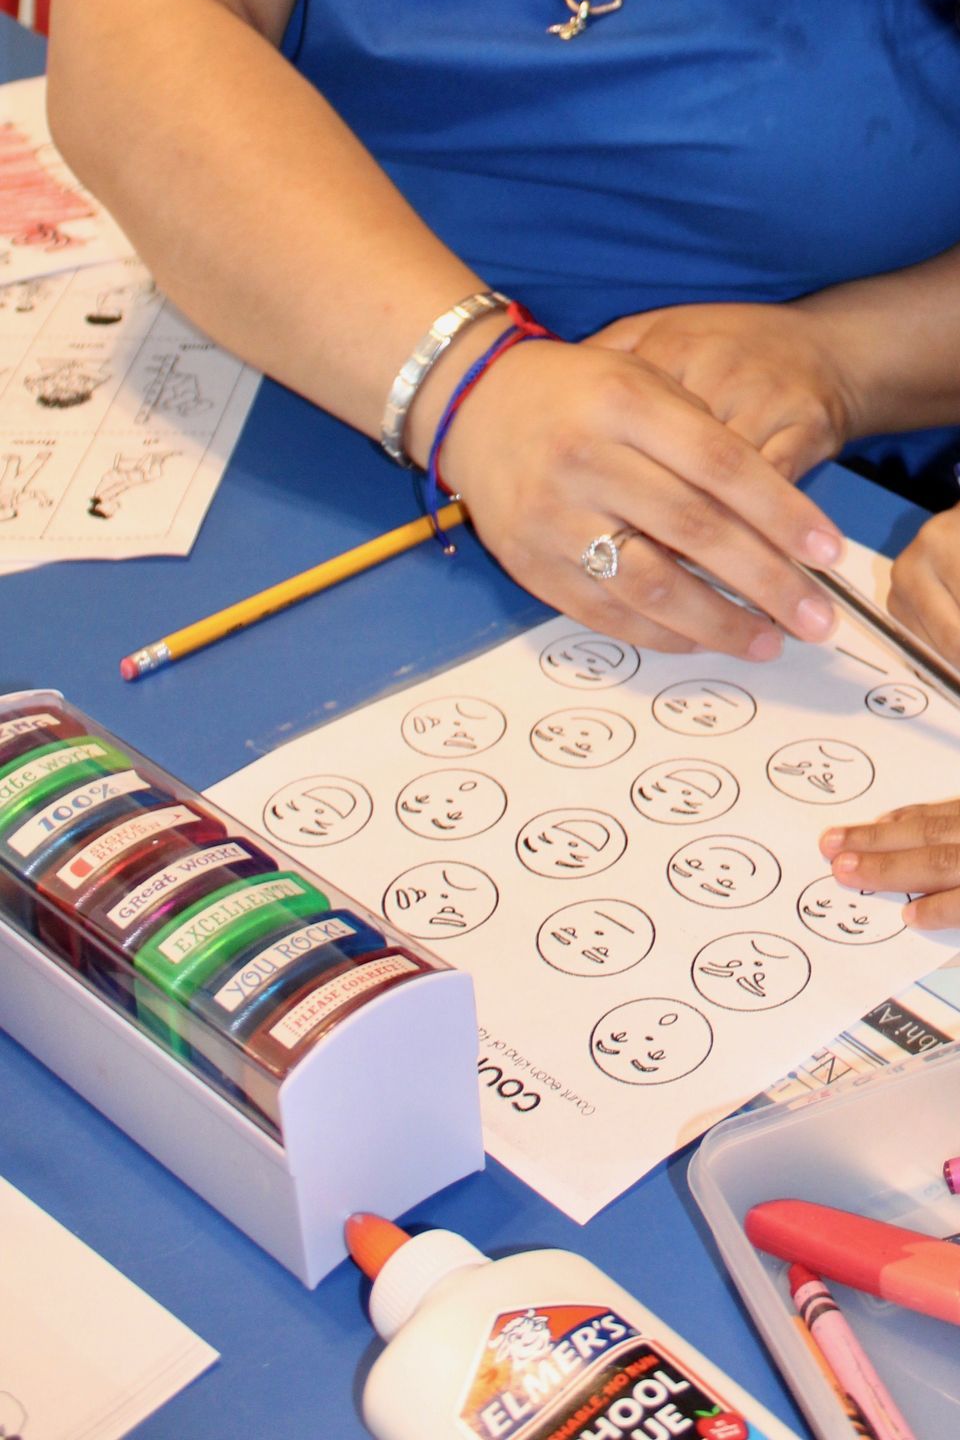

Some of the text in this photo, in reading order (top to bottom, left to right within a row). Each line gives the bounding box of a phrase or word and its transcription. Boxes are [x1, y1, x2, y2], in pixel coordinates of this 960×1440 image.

[38, 784, 121, 832] 100%
[226, 921, 347, 999] YOU ROCK!
[293, 988, 340, 1028] PLEASE
[477, 1057, 541, 1113] COU
[479, 1314, 628, 1437] ELMER'S
